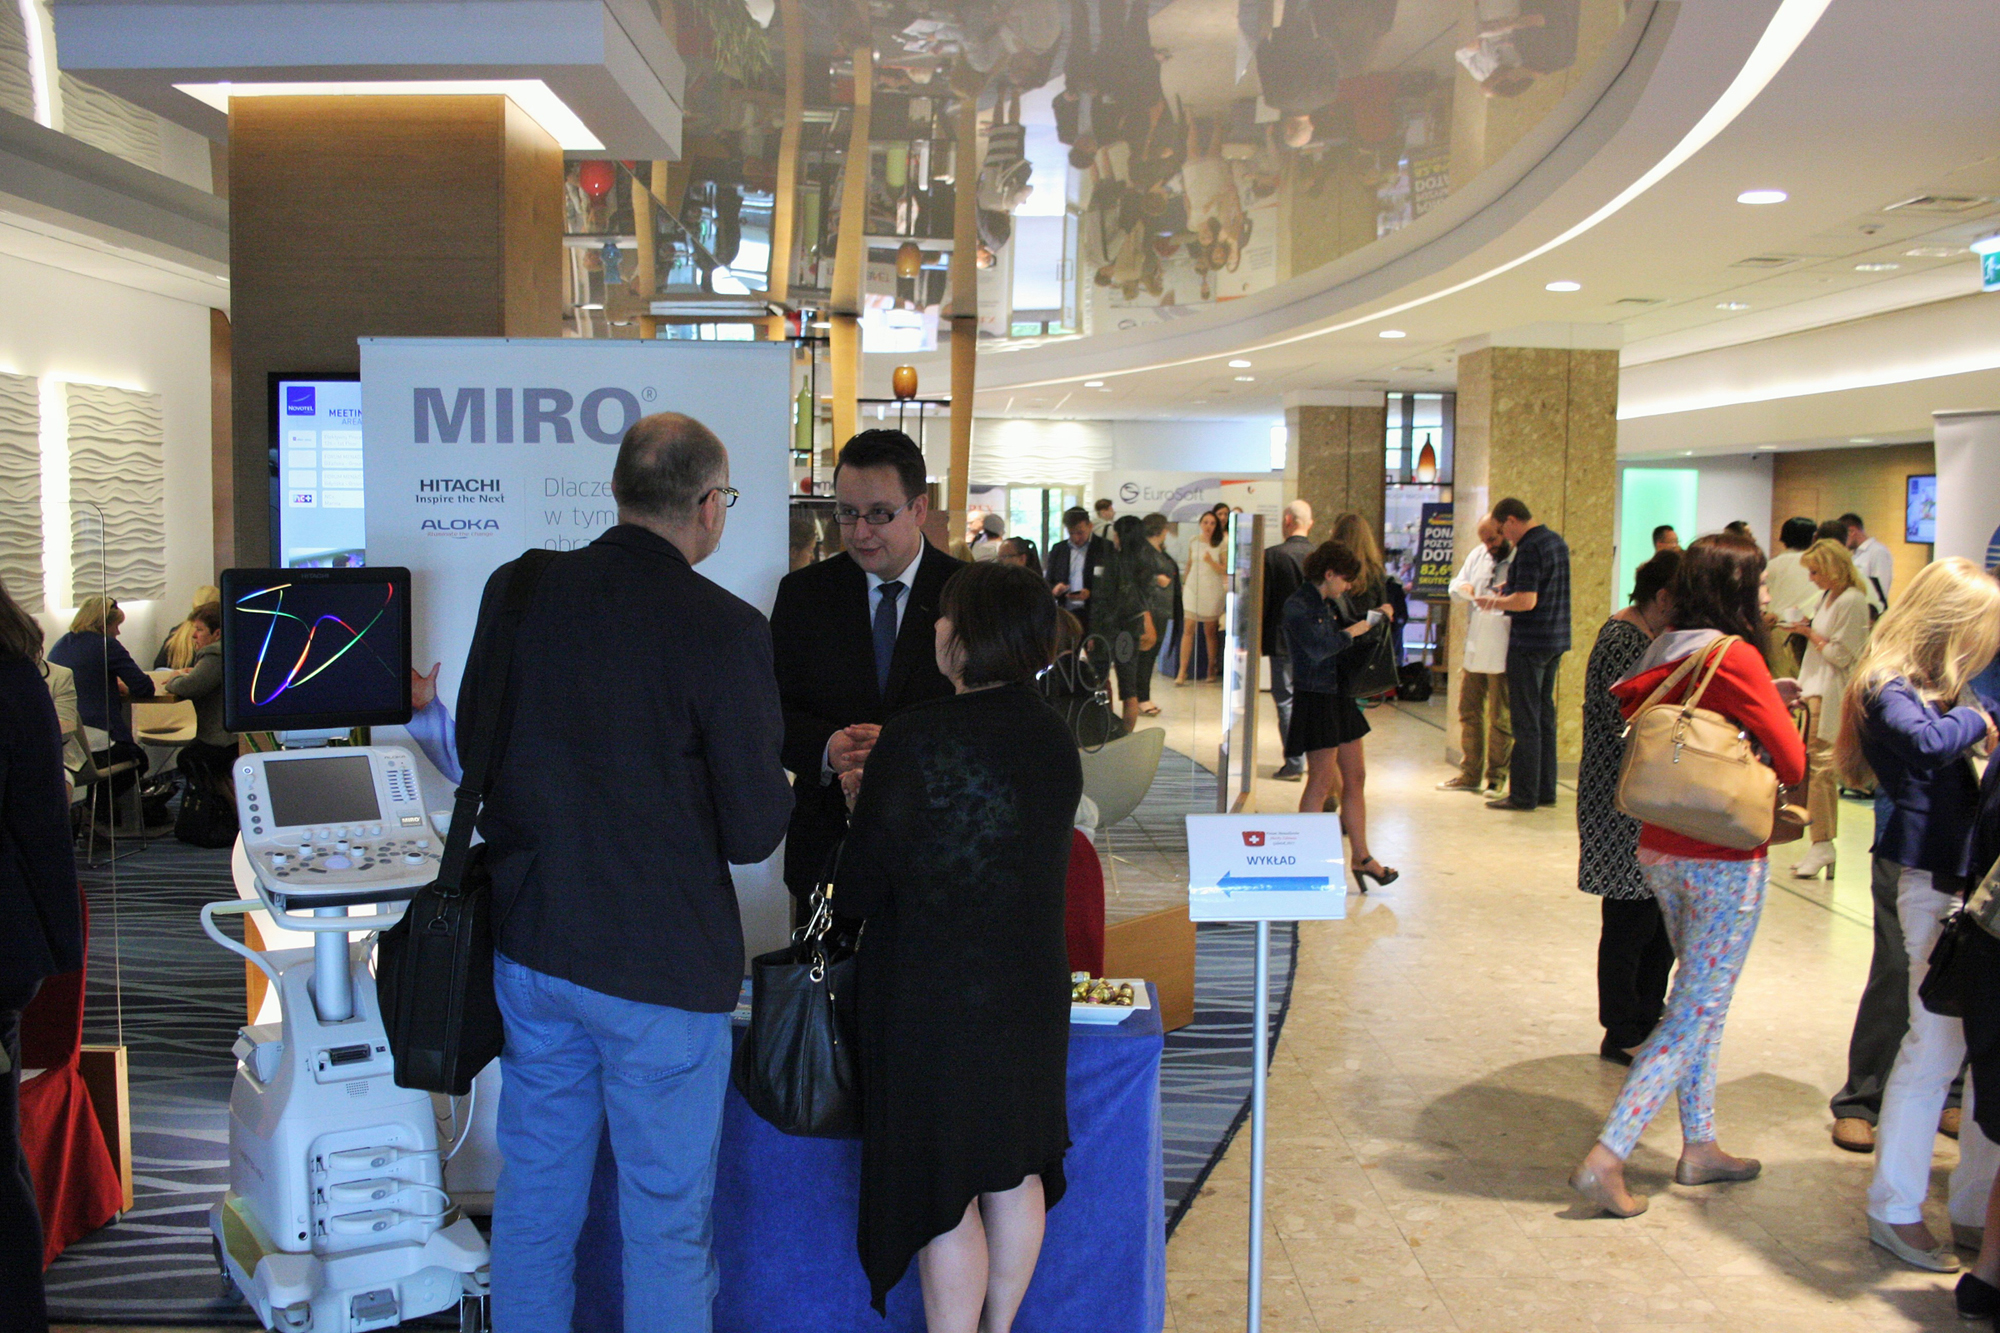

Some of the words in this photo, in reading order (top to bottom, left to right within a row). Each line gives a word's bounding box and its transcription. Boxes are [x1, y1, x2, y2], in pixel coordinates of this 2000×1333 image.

[420, 479, 500, 492] HITACHI
[415, 494, 454, 505] Inspire
[458, 494, 476, 504] the
[479, 493, 505, 504] Next
[544, 510, 562, 525] w
[573, 507, 615, 529] tym
[421, 519, 500, 530] ALOKA
[1422, 549, 1454, 562] DOT
[1246, 855, 1296, 866] WYKŁAD
